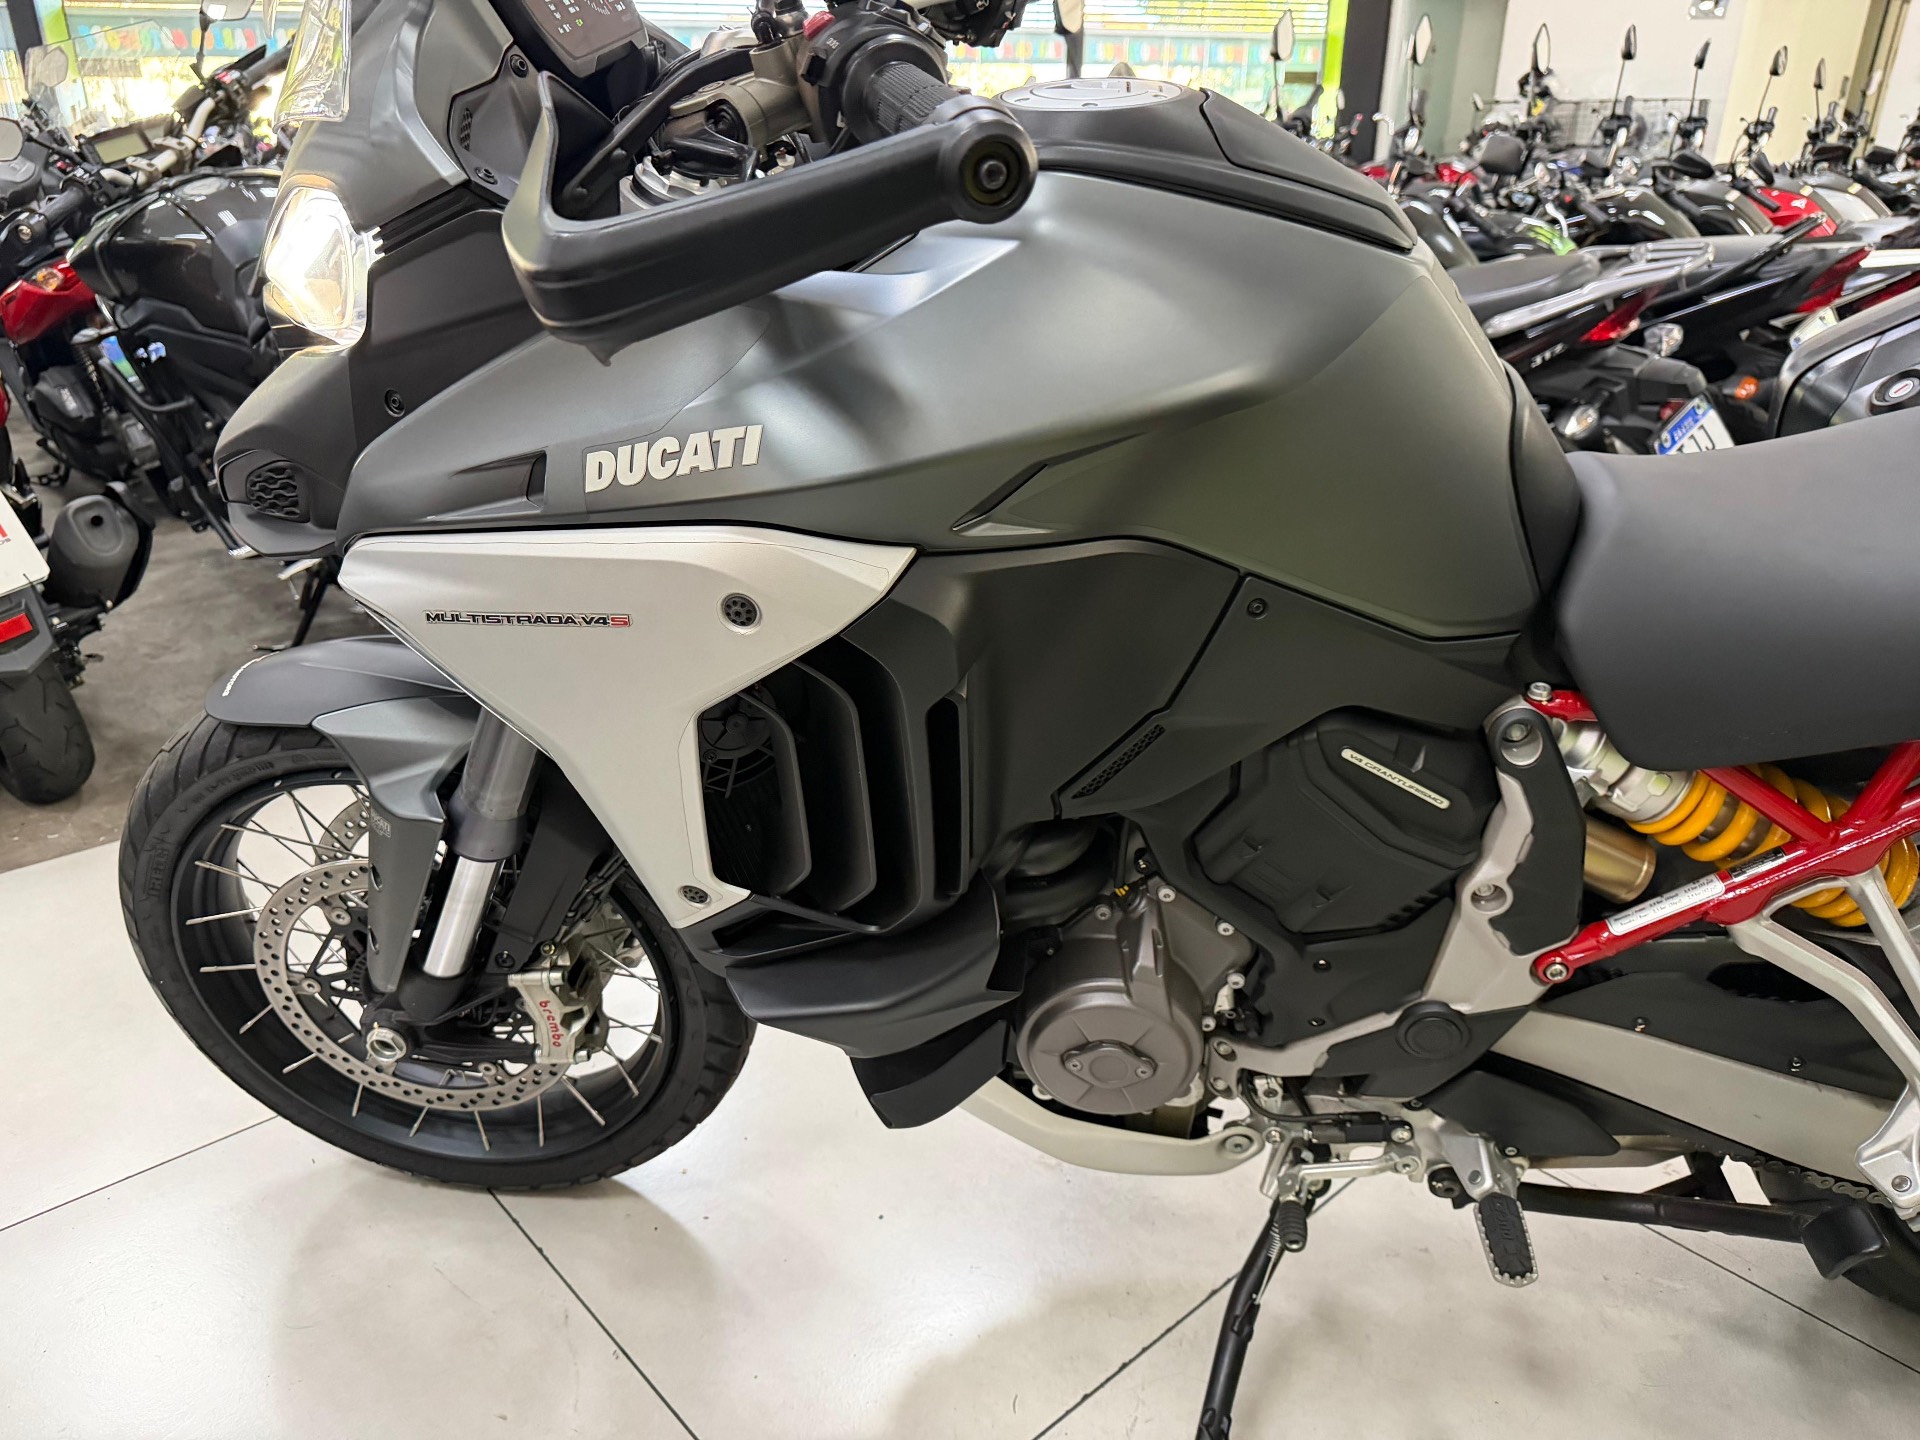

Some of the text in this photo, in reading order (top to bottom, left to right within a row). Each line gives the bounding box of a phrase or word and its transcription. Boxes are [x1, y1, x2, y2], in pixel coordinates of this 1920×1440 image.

[585, 424, 763, 493] DUCATI
[426, 611, 578, 626] MULTISTRADA
[1364, 761, 1444, 805] GRANTURISMO
[539, 999, 564, 1047] brembo
